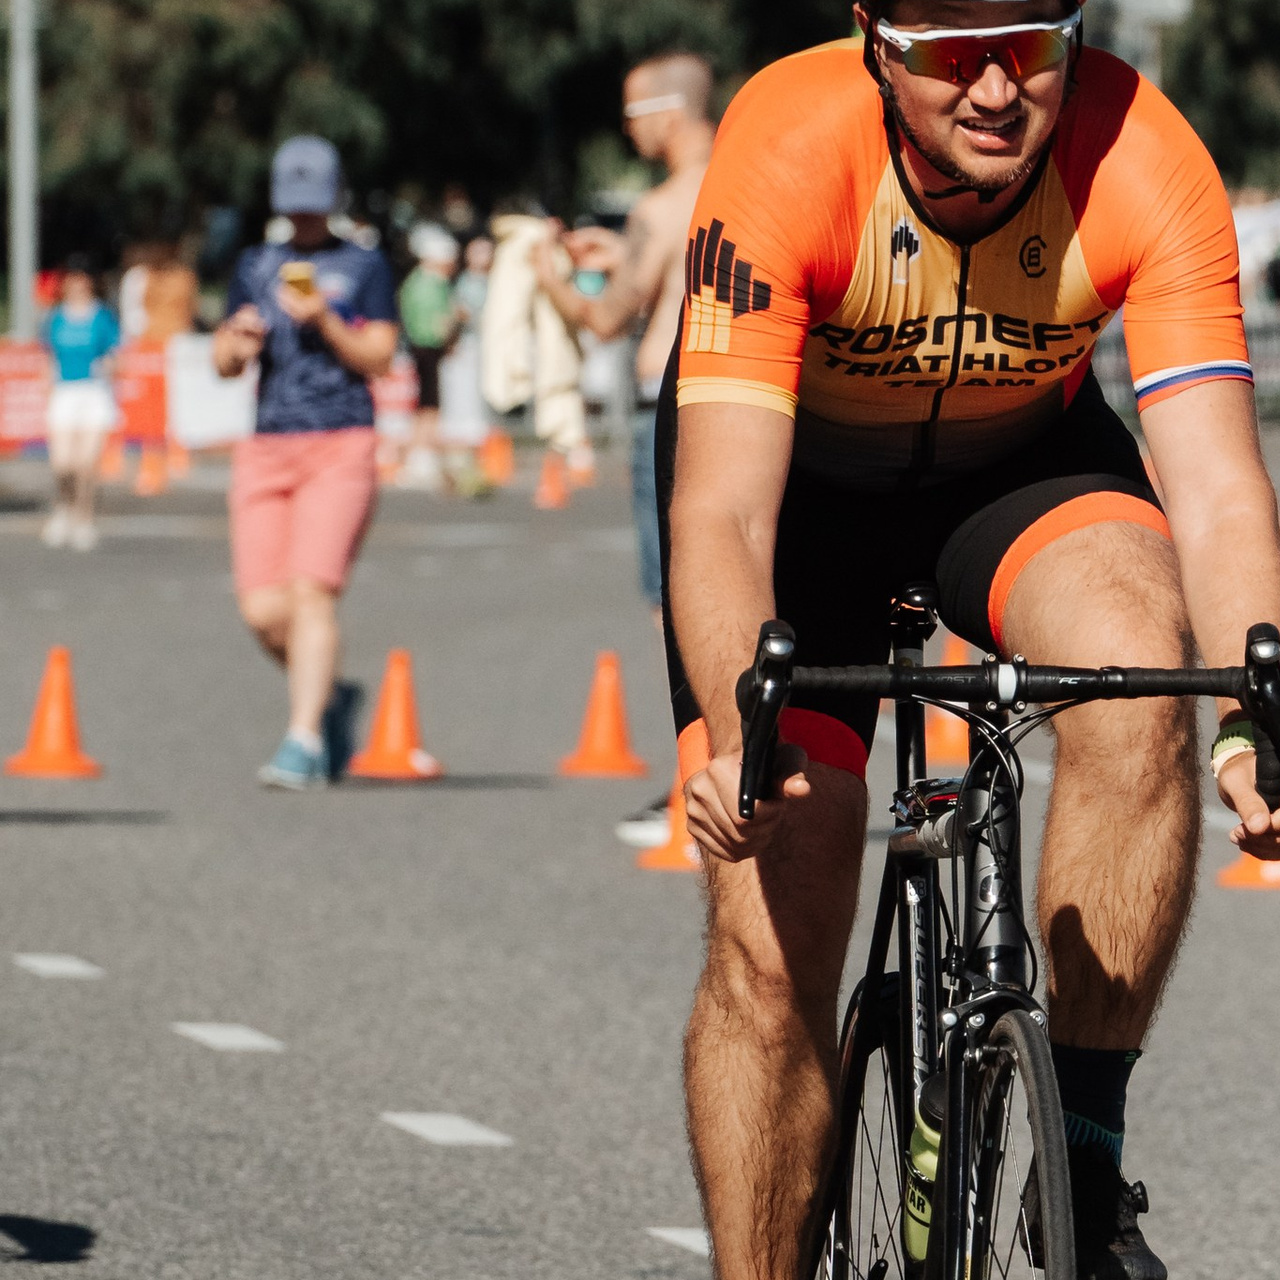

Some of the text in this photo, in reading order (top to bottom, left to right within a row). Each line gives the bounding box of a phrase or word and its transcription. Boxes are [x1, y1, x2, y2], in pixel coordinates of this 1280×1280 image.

[809, 310, 1109, 355] ROSNEFT
[824, 345, 1086, 377] TRIATHLON
[883, 377, 1036, 389] TEAM
